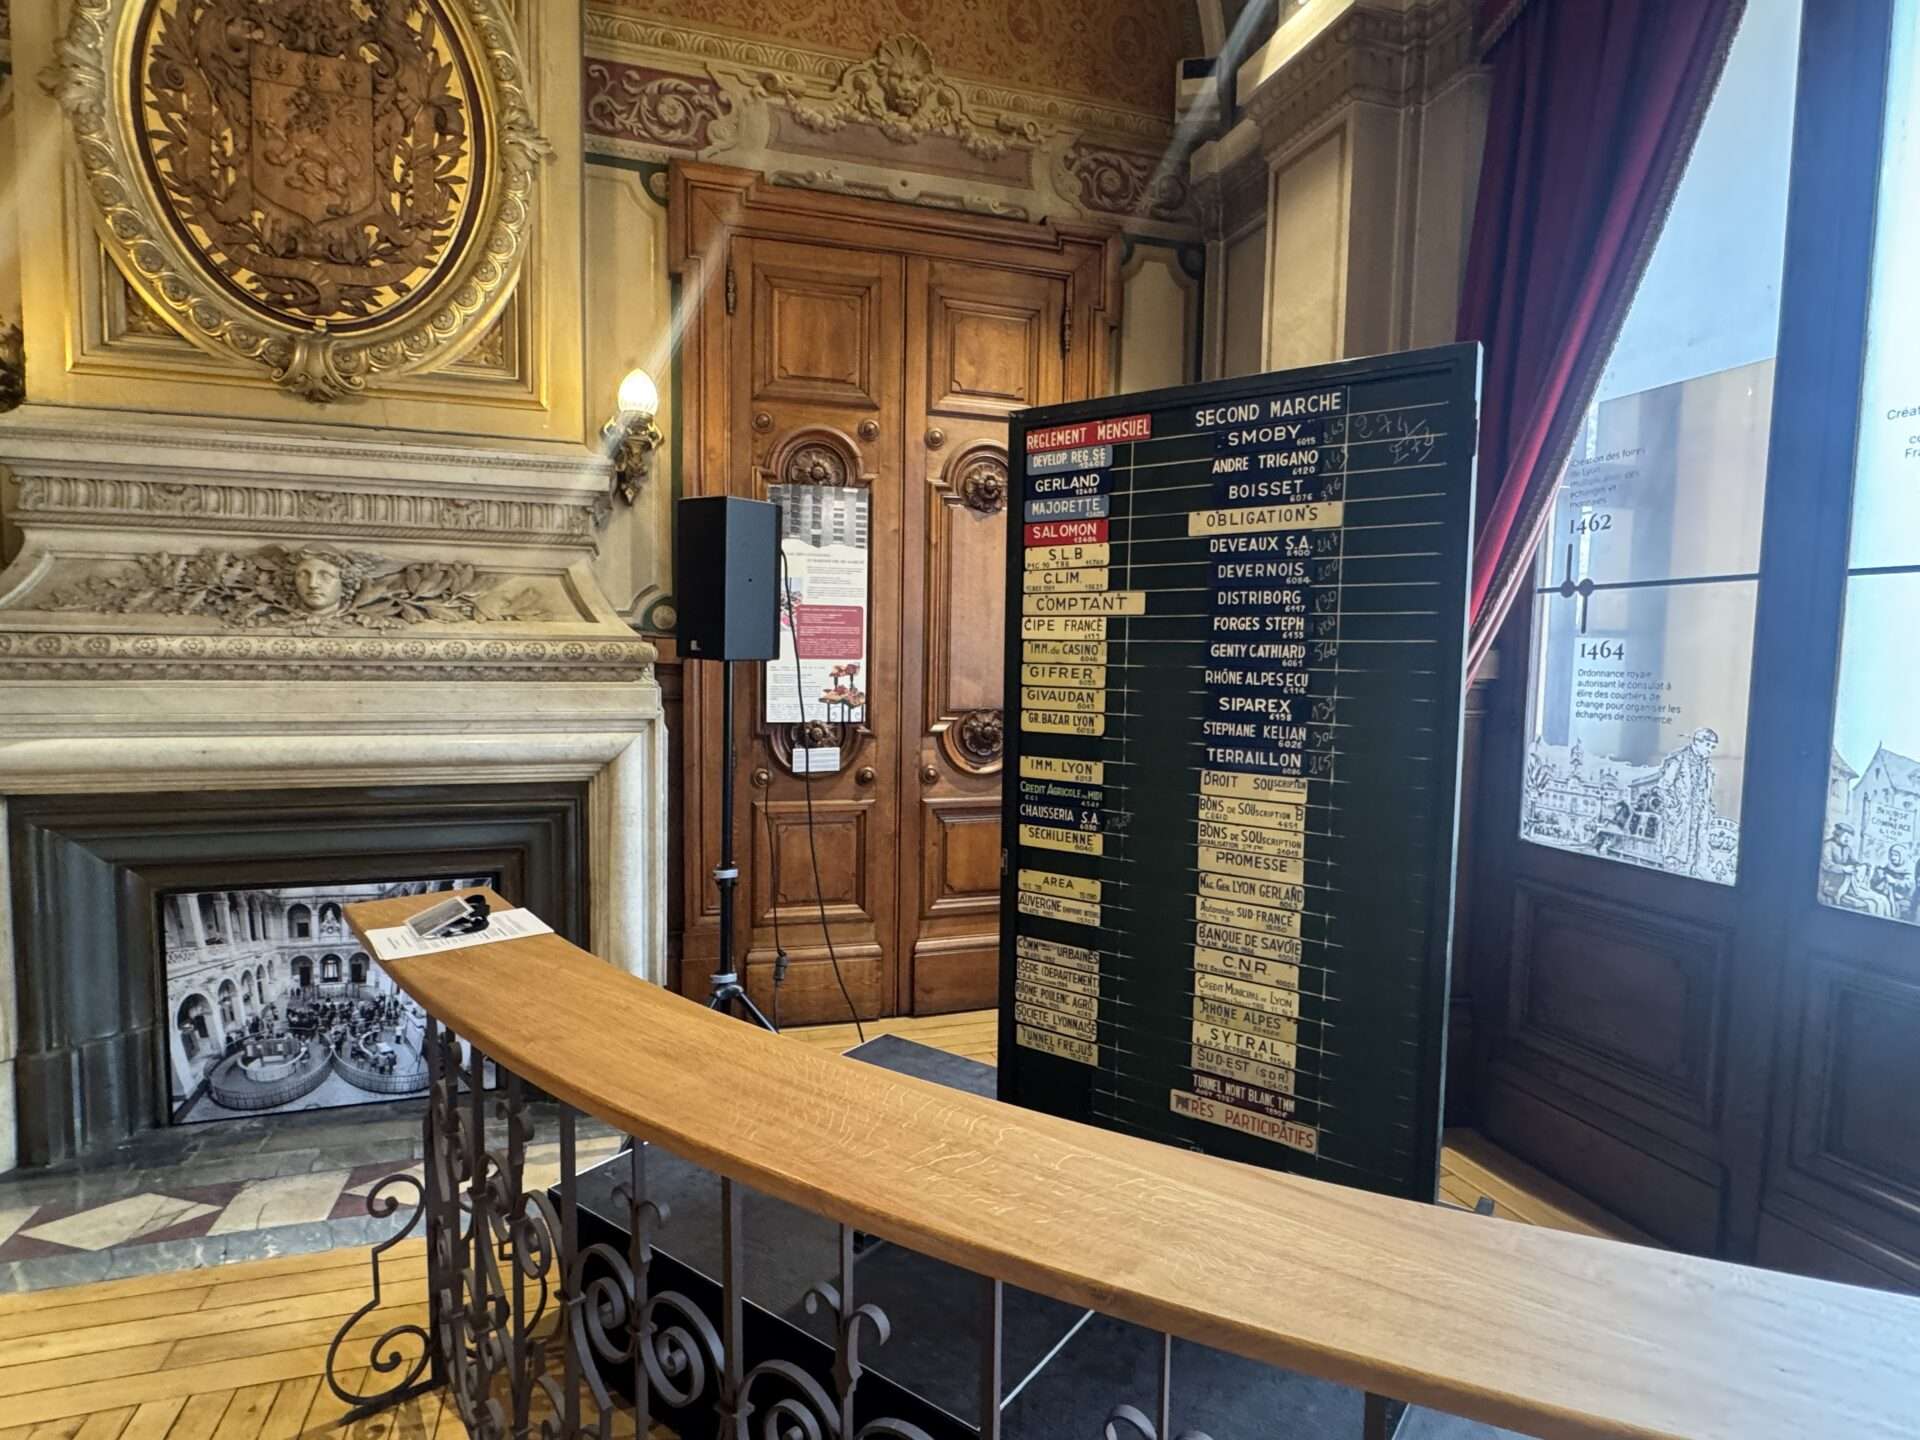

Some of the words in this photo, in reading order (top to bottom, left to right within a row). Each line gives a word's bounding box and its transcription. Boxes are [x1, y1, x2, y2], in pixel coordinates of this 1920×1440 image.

[1195, 404, 1260, 427] SECOND
[1270, 392, 1342, 418] MARCHE
[1026, 427, 1087, 449] REGLEMENT
[1098, 418, 1150, 441] MENSUEL
[1228, 424, 1301, 446] SMOBY
[1212, 457, 1249, 474] ANDRE
[1258, 450, 1319, 469] TRIGANO
[1035, 474, 1100, 492] GERLAND
[1228, 480, 1304, 500] BOISSET
[1032, 498, 1100, 516] MAJORETTE
[1206, 507, 1318, 527] OBLIGATIONS
[1570, 513, 1612, 534] 1462
[1032, 522, 1096, 538] SALOMON
[1210, 536, 1278, 552] DEVEAUX
[1285, 536, 1313, 550] S.A.
[1218, 562, 1304, 578] DEVERNOIS
[1036, 597, 1127, 610] COMPTANT
[1218, 590, 1301, 605] DISTRIBORG
[1024, 620, 1055, 631] CIPE
[1064, 620, 1102, 632] FRANCE
[1214, 617, 1260, 630] FORGES
[1265, 617, 1304, 630] STEPH
[1062, 644, 1098, 656] CASINO
[1210, 644, 1248, 657] GENTY
[1250, 645, 1305, 658] CATHIARD
[1580, 640, 1624, 660] 1464
[1030, 666, 1093, 679] GIFRER
[1245, 672, 1283, 686] ALPES
[1286, 673, 1308, 686] ECU
[1578, 669, 1624, 678] Ordonnance
[1577, 680, 1616, 688] autorisant
[1027, 689, 1094, 703] GIVAUDAN
[1594, 690, 1608, 699] des
[1219, 697, 1291, 713] SIPAREX
[1576, 700, 1604, 710] change
[1606, 702, 1624, 711] pour
[1668, 704, 1680, 713] les
[1042, 713, 1070, 726] BAZAR
[1073, 715, 1094, 727] LYON
[1576, 710, 1612, 721] échanges
[1203, 721, 1256, 737] STEPHANE
[1264, 725, 1306, 740] KELIAN
[1031, 758, 1056, 772] IMM.
[1062, 762, 1092, 774] LYON
[1206, 748, 1301, 767] TERRAILLON
[1204, 774, 1239, 787] DROIT
[1020, 804, 1074, 822] CHAUSSERIA
[1200, 798, 1224, 812] BONS
[1238, 803, 1290, 820] SOUSCRIPTION
[1296, 807, 1303, 821] B
[1200, 825, 1227, 839] BONS
[1241, 830, 1301, 849] SOUSCRIPTION
[1216, 851, 1288, 872] PROMESSE
[1042, 876, 1074, 890] AREA
[1233, 881, 1255, 896] LYON
[1260, 884, 1302, 903] GERLAND
[1019, 894, 1062, 912] AUVERGNE
[1237, 907, 1253, 919] SUD
[1256, 910, 1292, 927] FRANCE
[1200, 926, 1242, 944] BANQUE
[1245, 934, 1258, 947] DE
[1261, 937, 1300, 956] SAVOIE
[1271, 991, 1292, 1008] LYON
[1200, 1001, 1237, 1019] RHONE
[1243, 1012, 1280, 1029] ALPES
[1053, 1014, 1096, 1035] LYONNAISE
[1022, 1026, 1055, 1046] TUNNEL
[1210, 1028, 1280, 1056] SYTRAL
[1198, 1048, 1250, 1072] SUD-EST
[1225, 1110, 1313, 1148] PARTICIPATIFS
